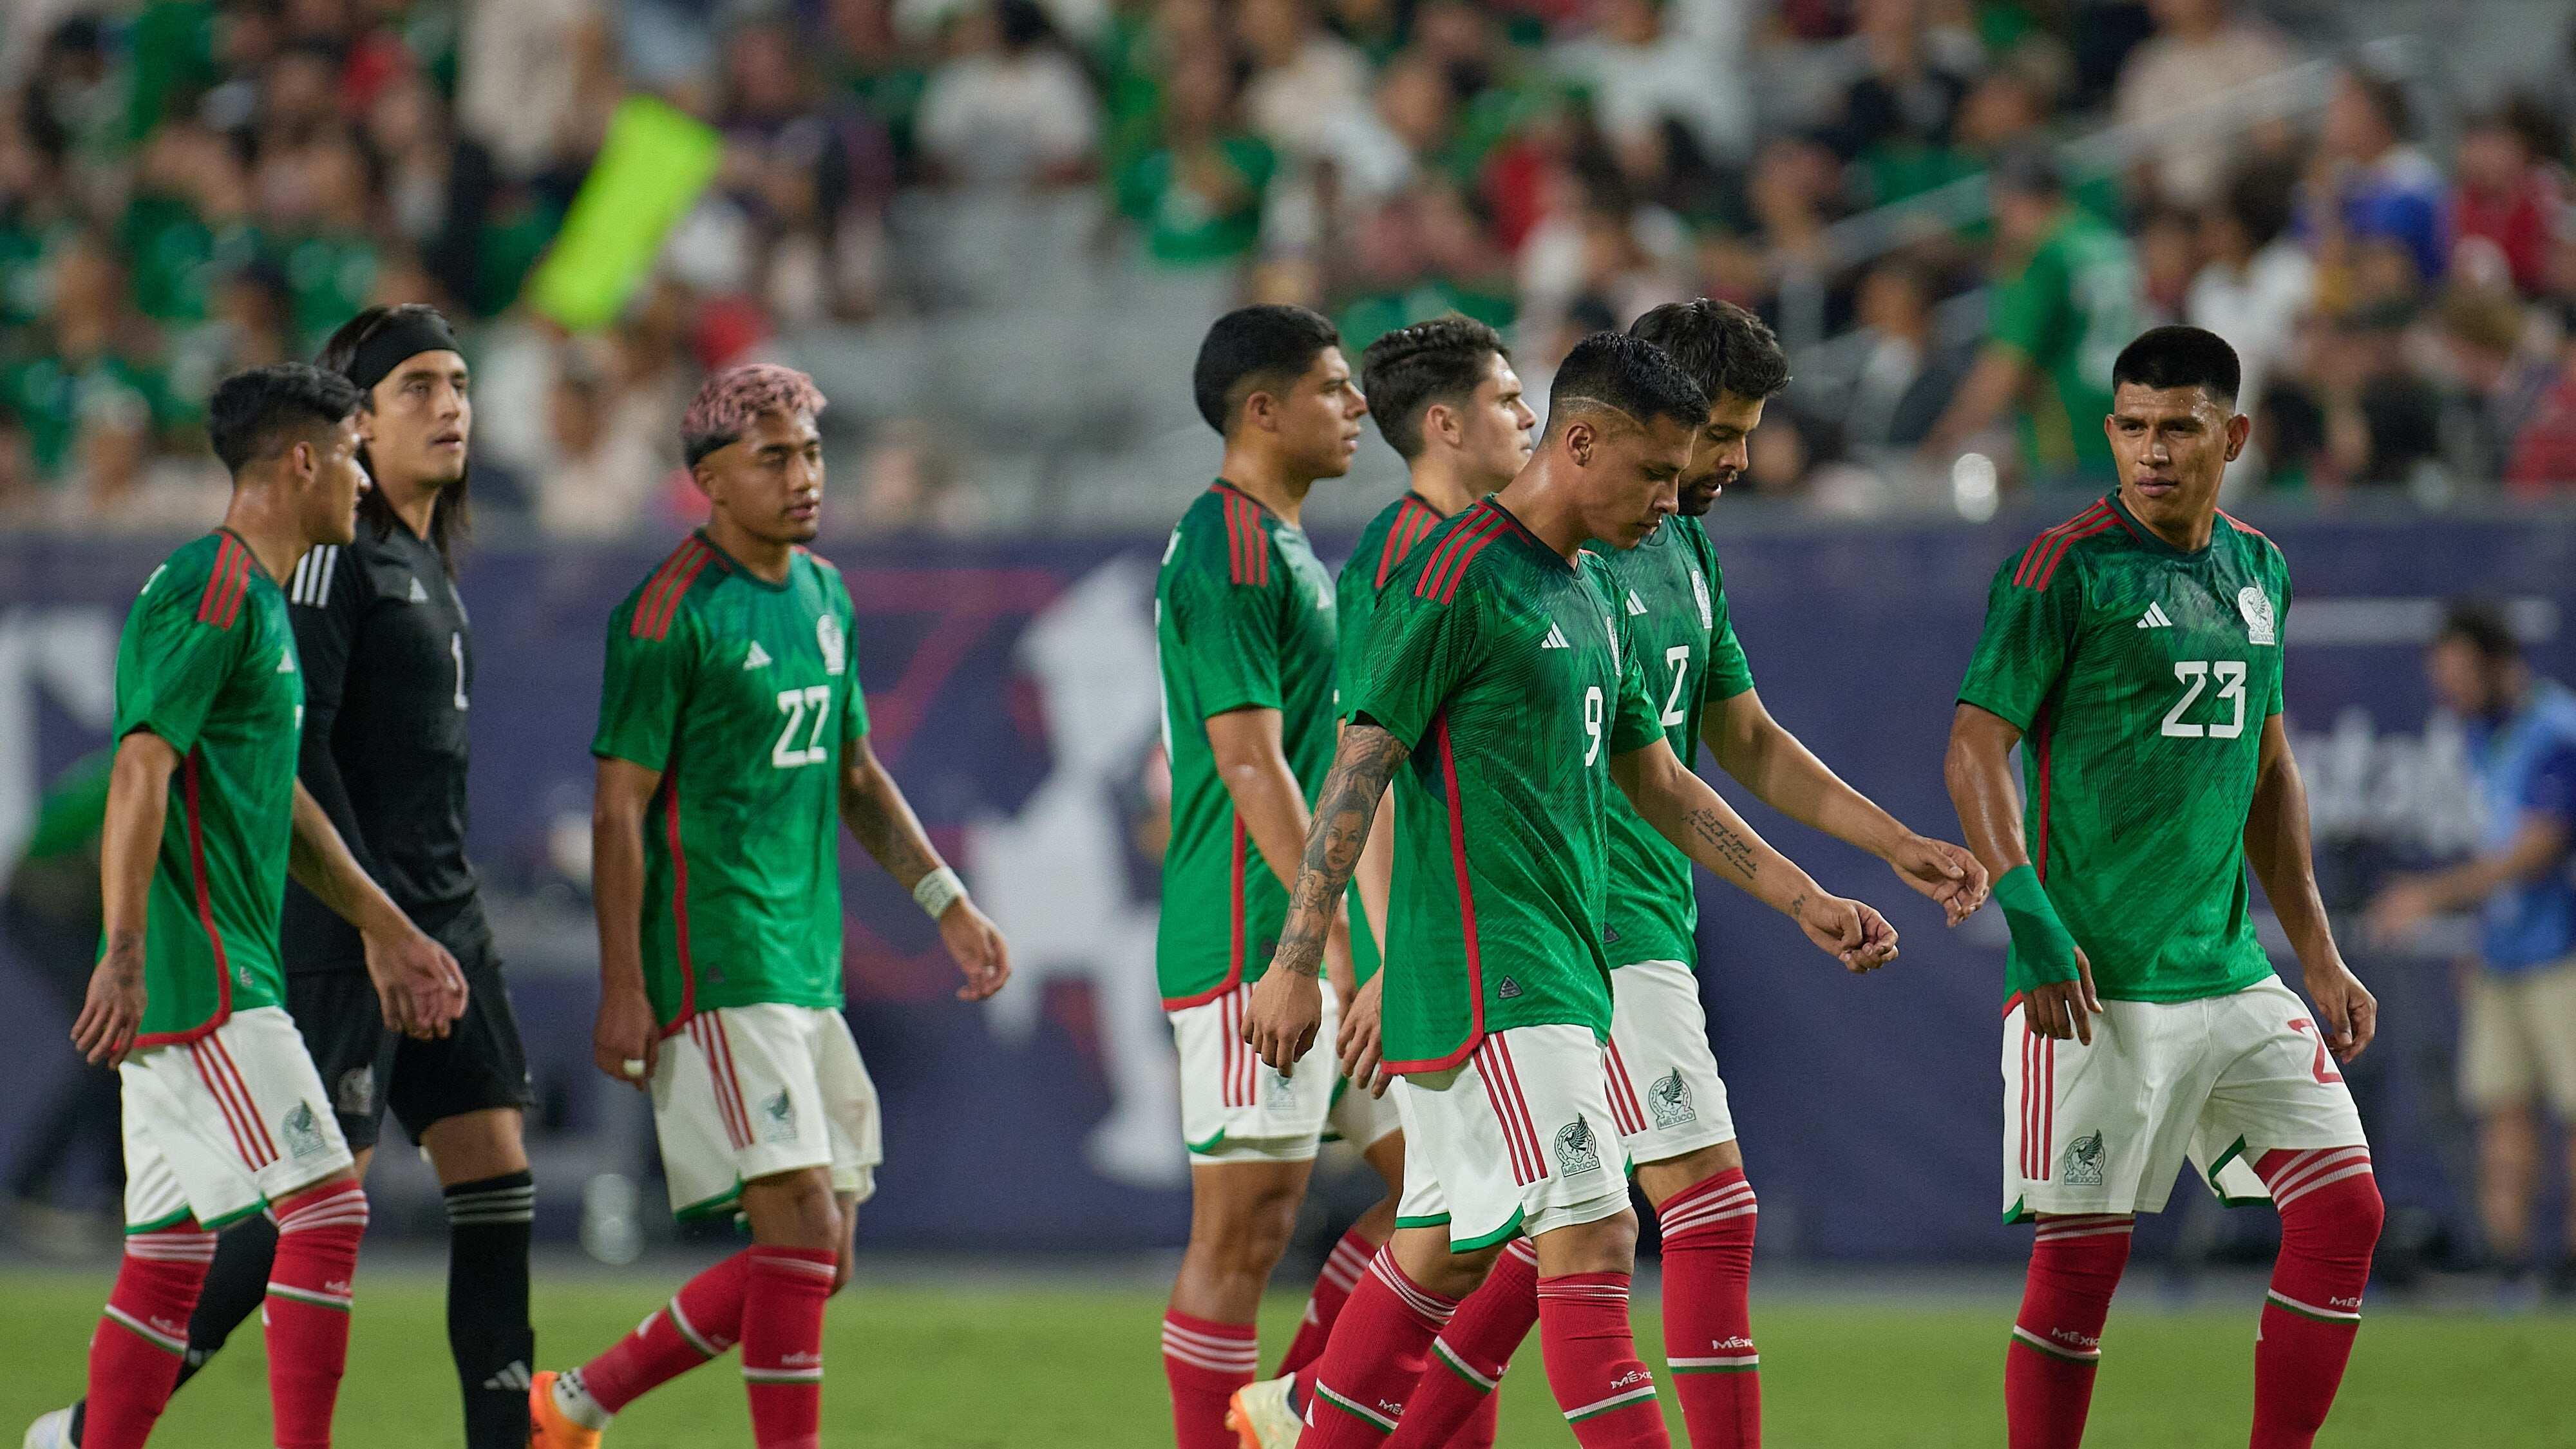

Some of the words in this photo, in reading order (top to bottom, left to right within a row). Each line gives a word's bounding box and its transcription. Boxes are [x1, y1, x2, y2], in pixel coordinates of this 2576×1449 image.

[1662, 645, 1689, 726] 2
[2161, 661, 2246, 738] 23
[772, 685, 830, 768] 22
[1585, 687, 1603, 766] 9
[1564, 1160, 1597, 1175] MÉXICO
